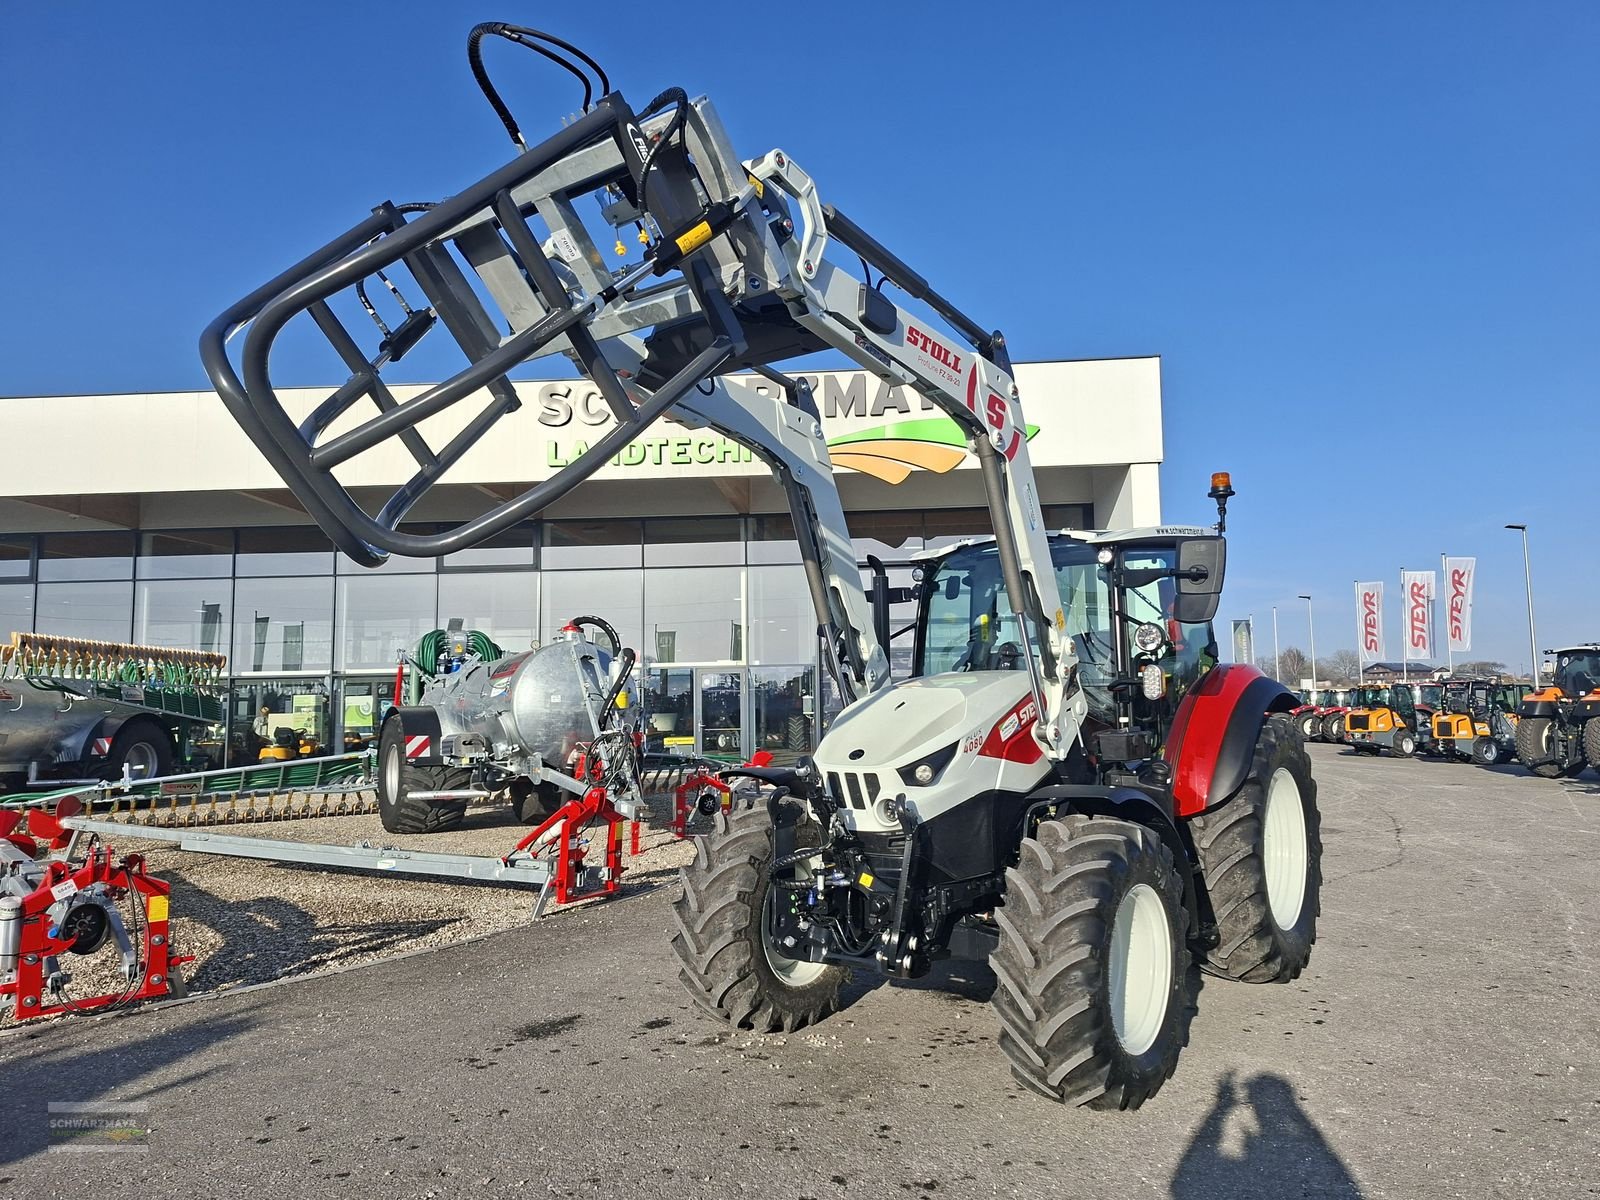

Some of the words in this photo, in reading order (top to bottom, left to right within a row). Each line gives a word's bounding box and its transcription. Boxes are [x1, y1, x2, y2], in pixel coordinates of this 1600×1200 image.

[906, 325, 962, 375] STOLL
[987, 393, 1007, 430] S
[1363, 591, 1378, 653] STEYR
[1410, 582, 1426, 650] STEYR
[1449, 568, 1466, 642] STEYR
[1020, 701, 1036, 726] STE
[963, 735, 984, 754] 4080
